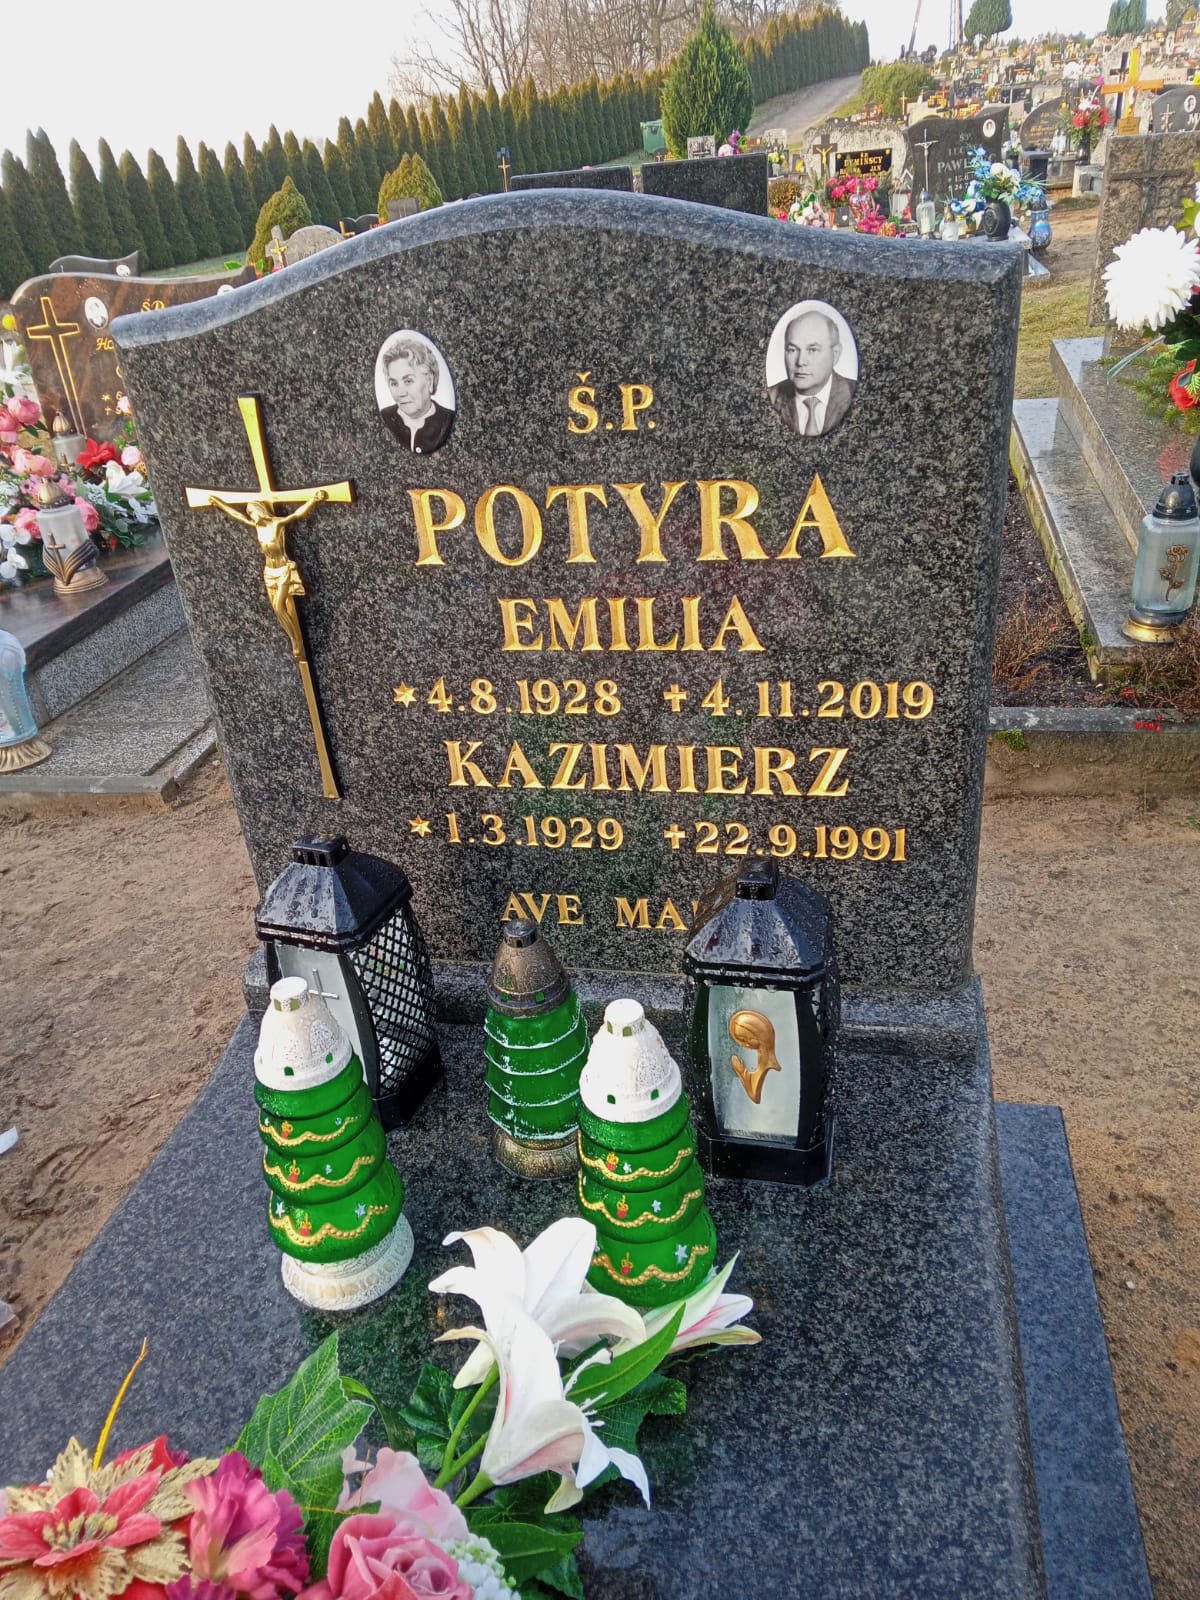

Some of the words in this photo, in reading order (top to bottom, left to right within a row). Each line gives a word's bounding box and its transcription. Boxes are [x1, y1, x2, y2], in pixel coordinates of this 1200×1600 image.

[407, 473, 857, 567] POTYRA
[498, 594, 766, 653] EMILIA
[443, 739, 850, 798] KAZIMIERZ
[501, 890, 584, 926] AVE
